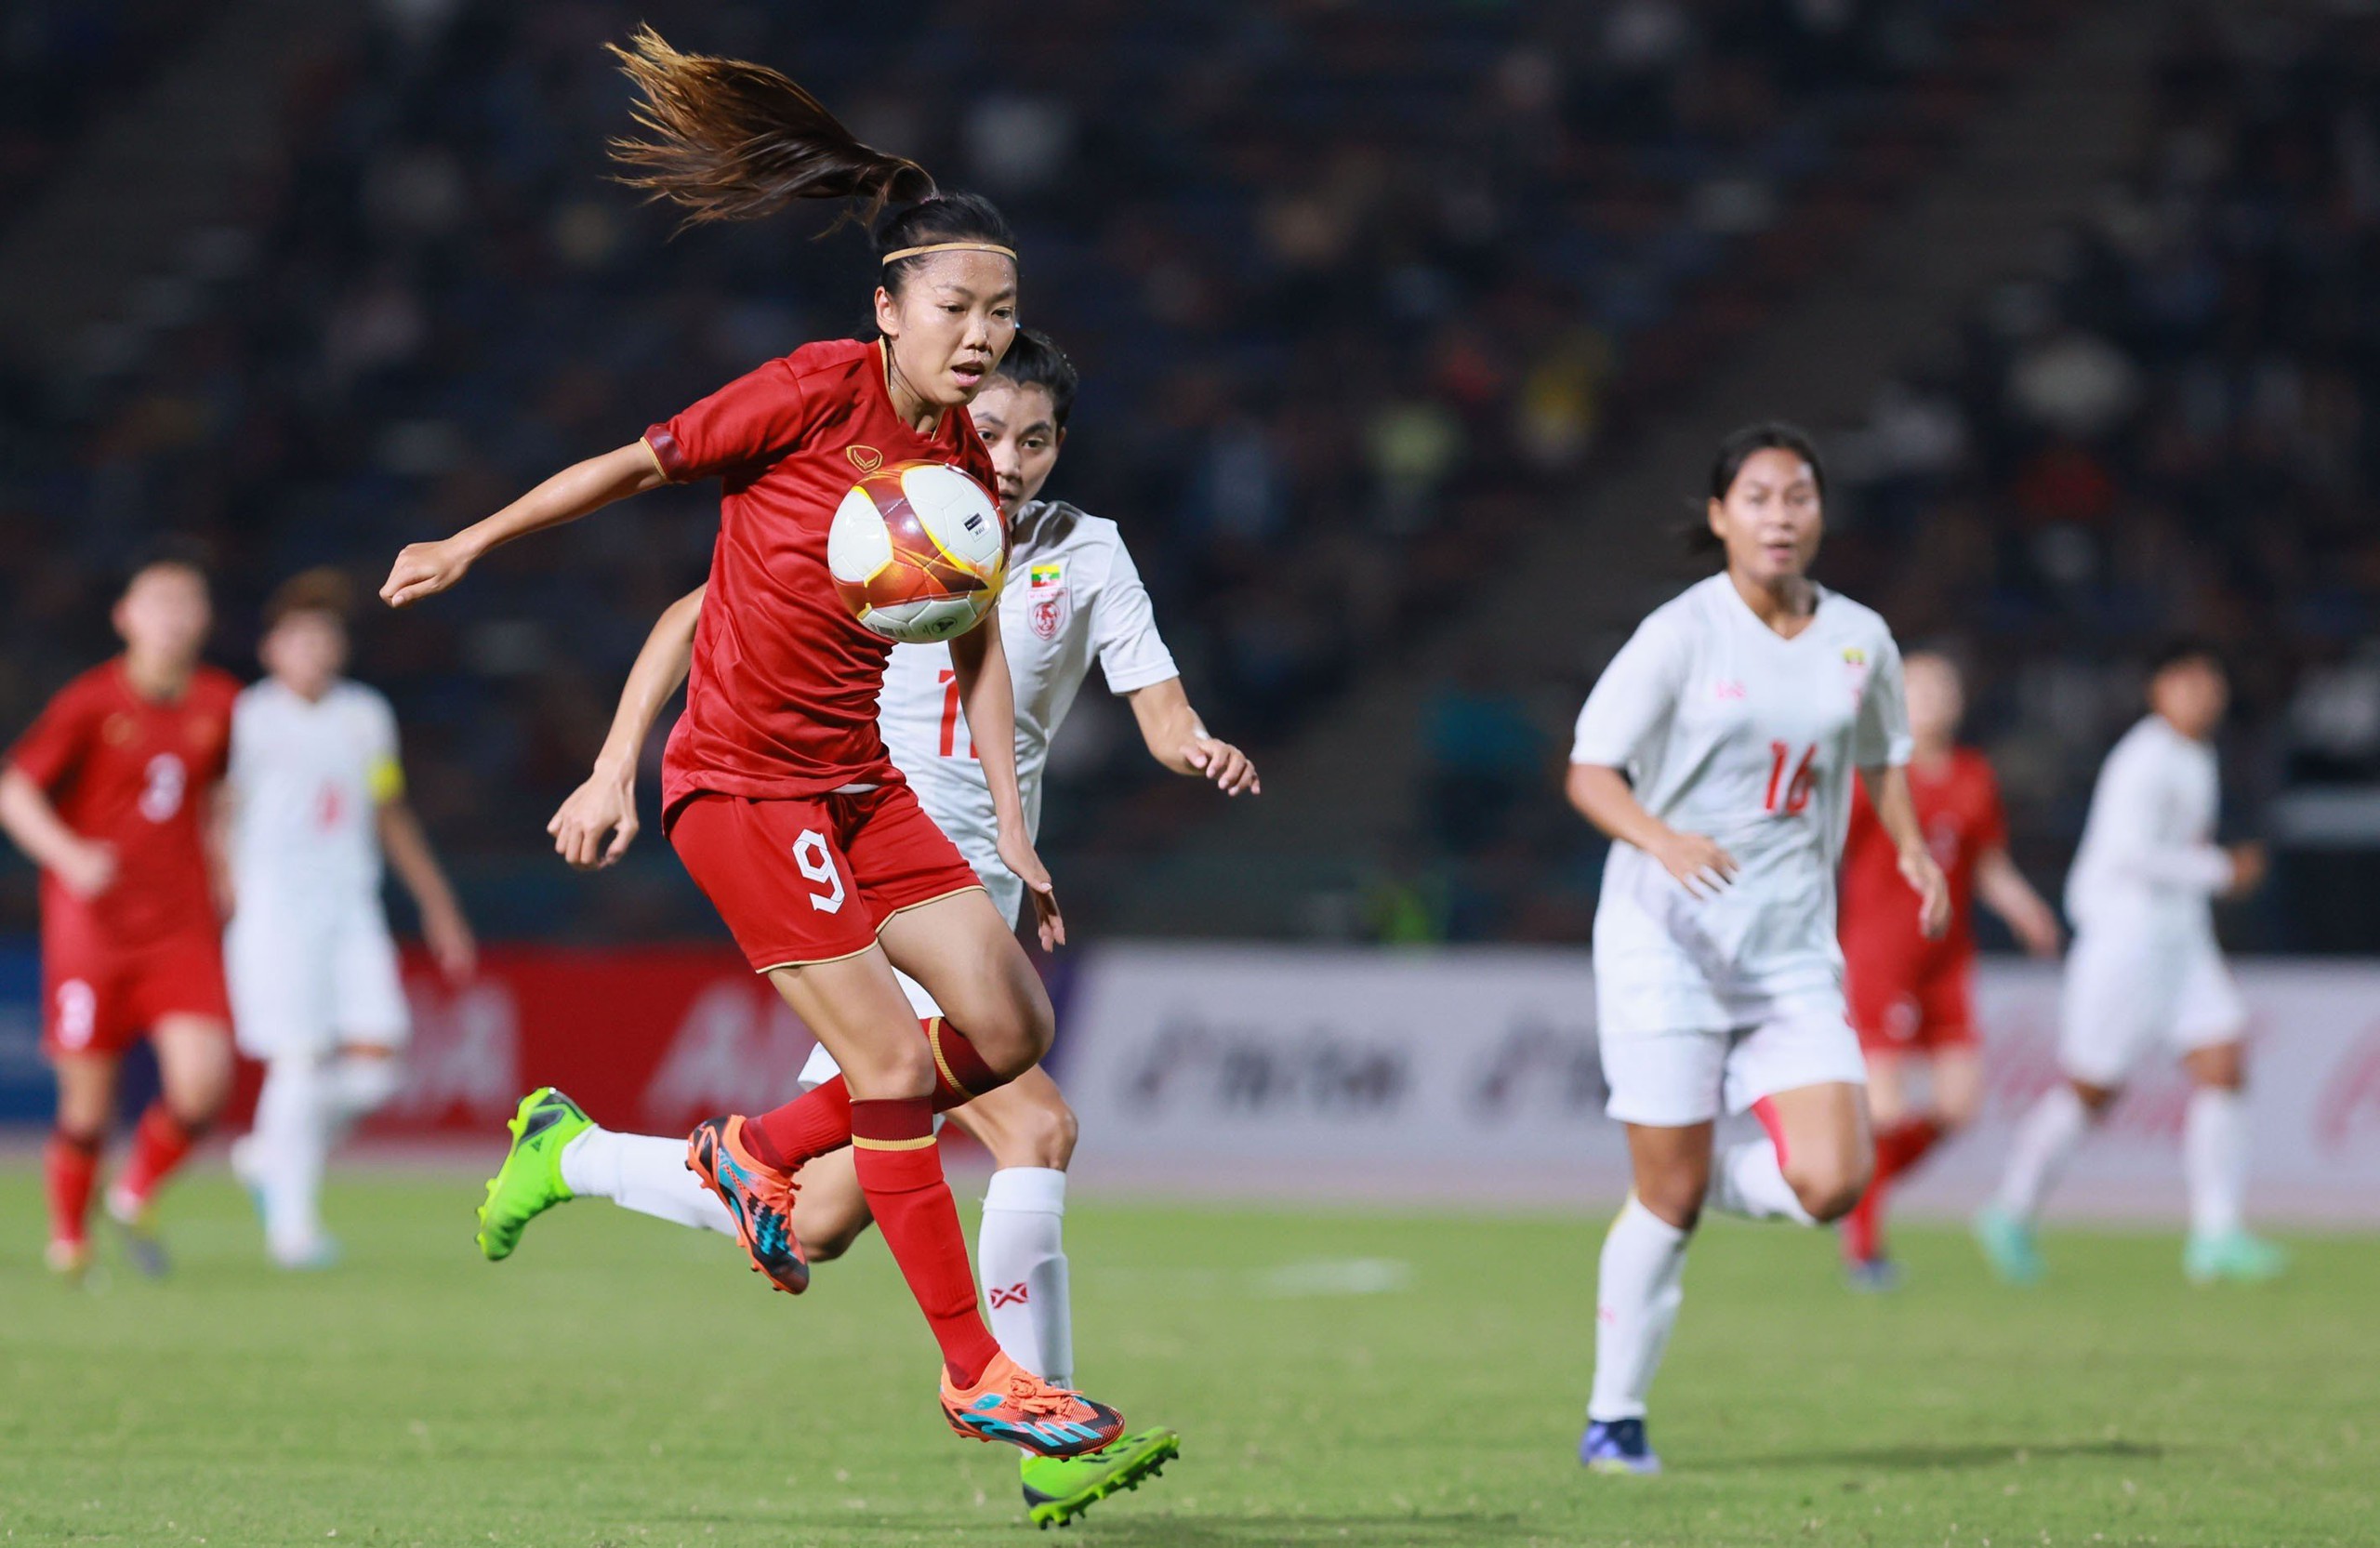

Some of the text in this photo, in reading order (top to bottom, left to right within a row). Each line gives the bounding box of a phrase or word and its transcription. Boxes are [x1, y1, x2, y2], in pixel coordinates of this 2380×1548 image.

[938, 669, 980, 760] 1
[1765, 741, 1817, 816] 16
[792, 828, 845, 914] 9
